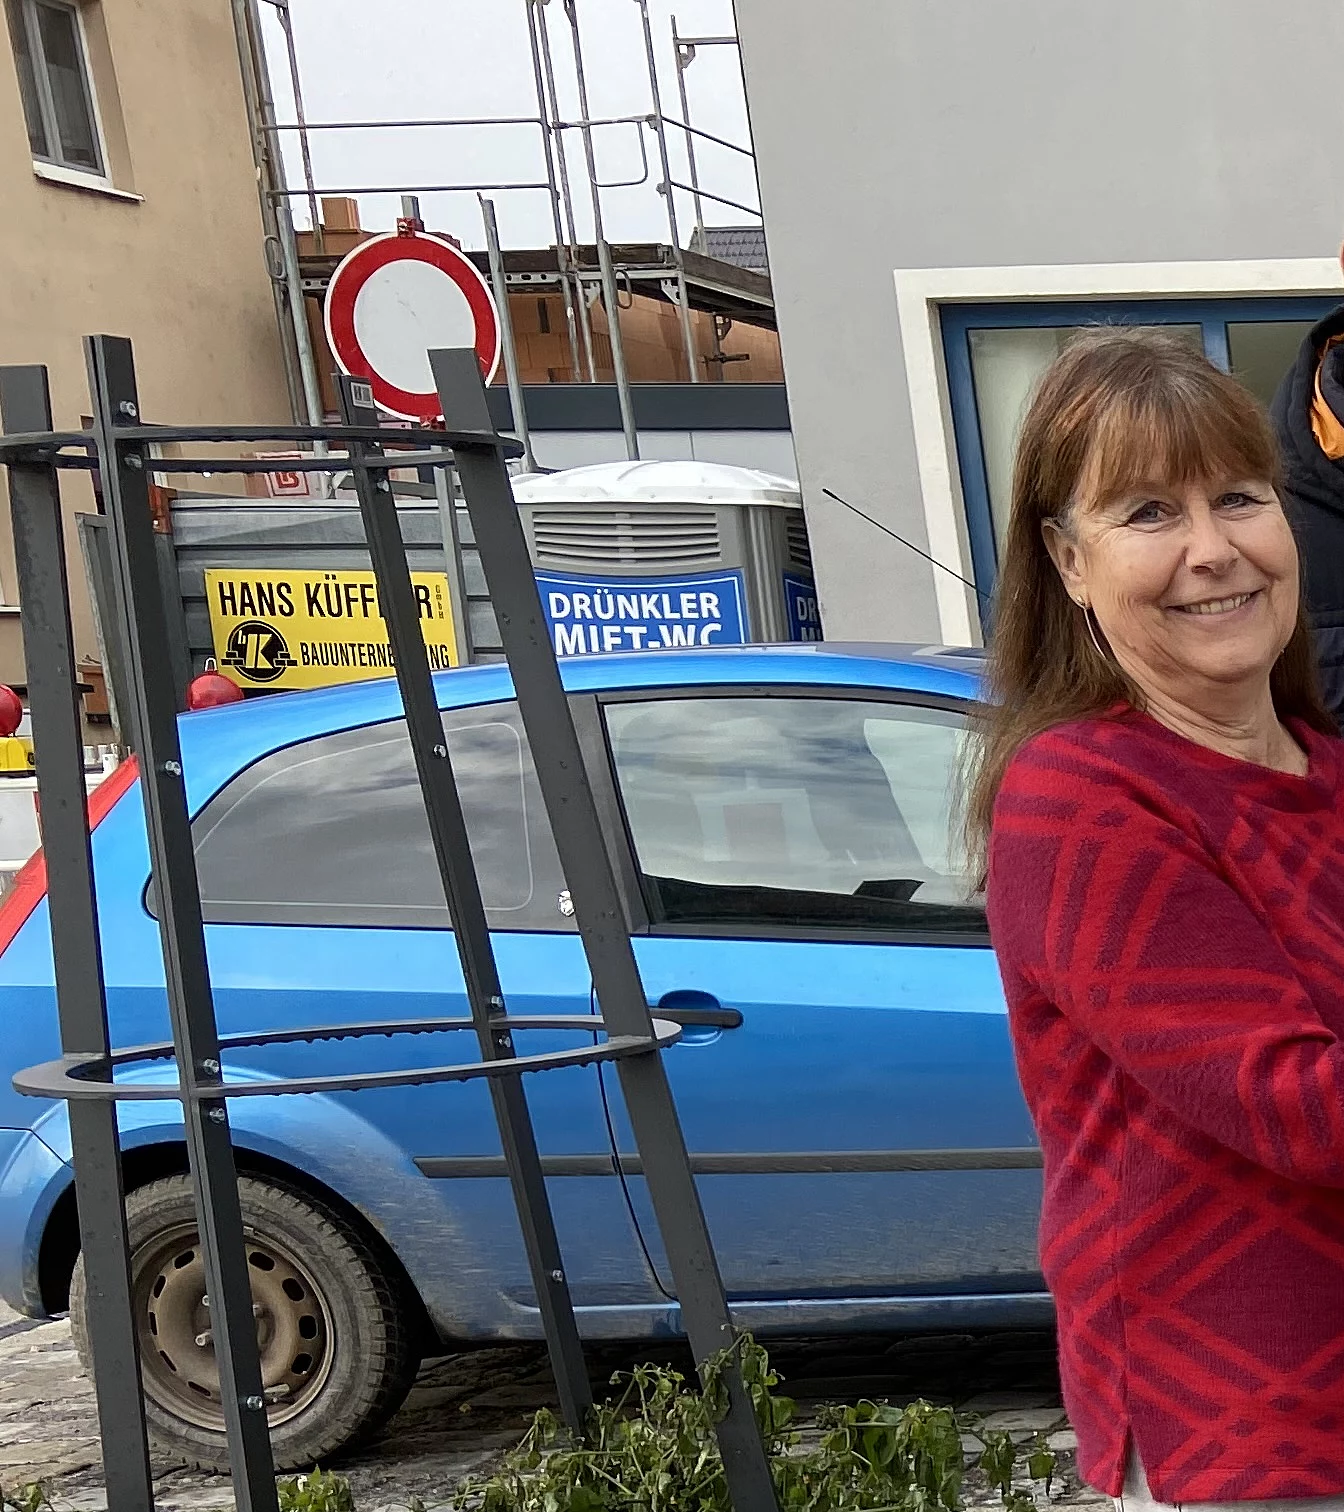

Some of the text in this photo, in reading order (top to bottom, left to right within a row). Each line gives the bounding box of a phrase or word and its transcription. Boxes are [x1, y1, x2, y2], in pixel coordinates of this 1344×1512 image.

[217, 573, 434, 620] HANS KÜFFR
[548, 588, 722, 620] DRÜNKLER
[299, 641, 450, 669] BAUUNTERNENG
